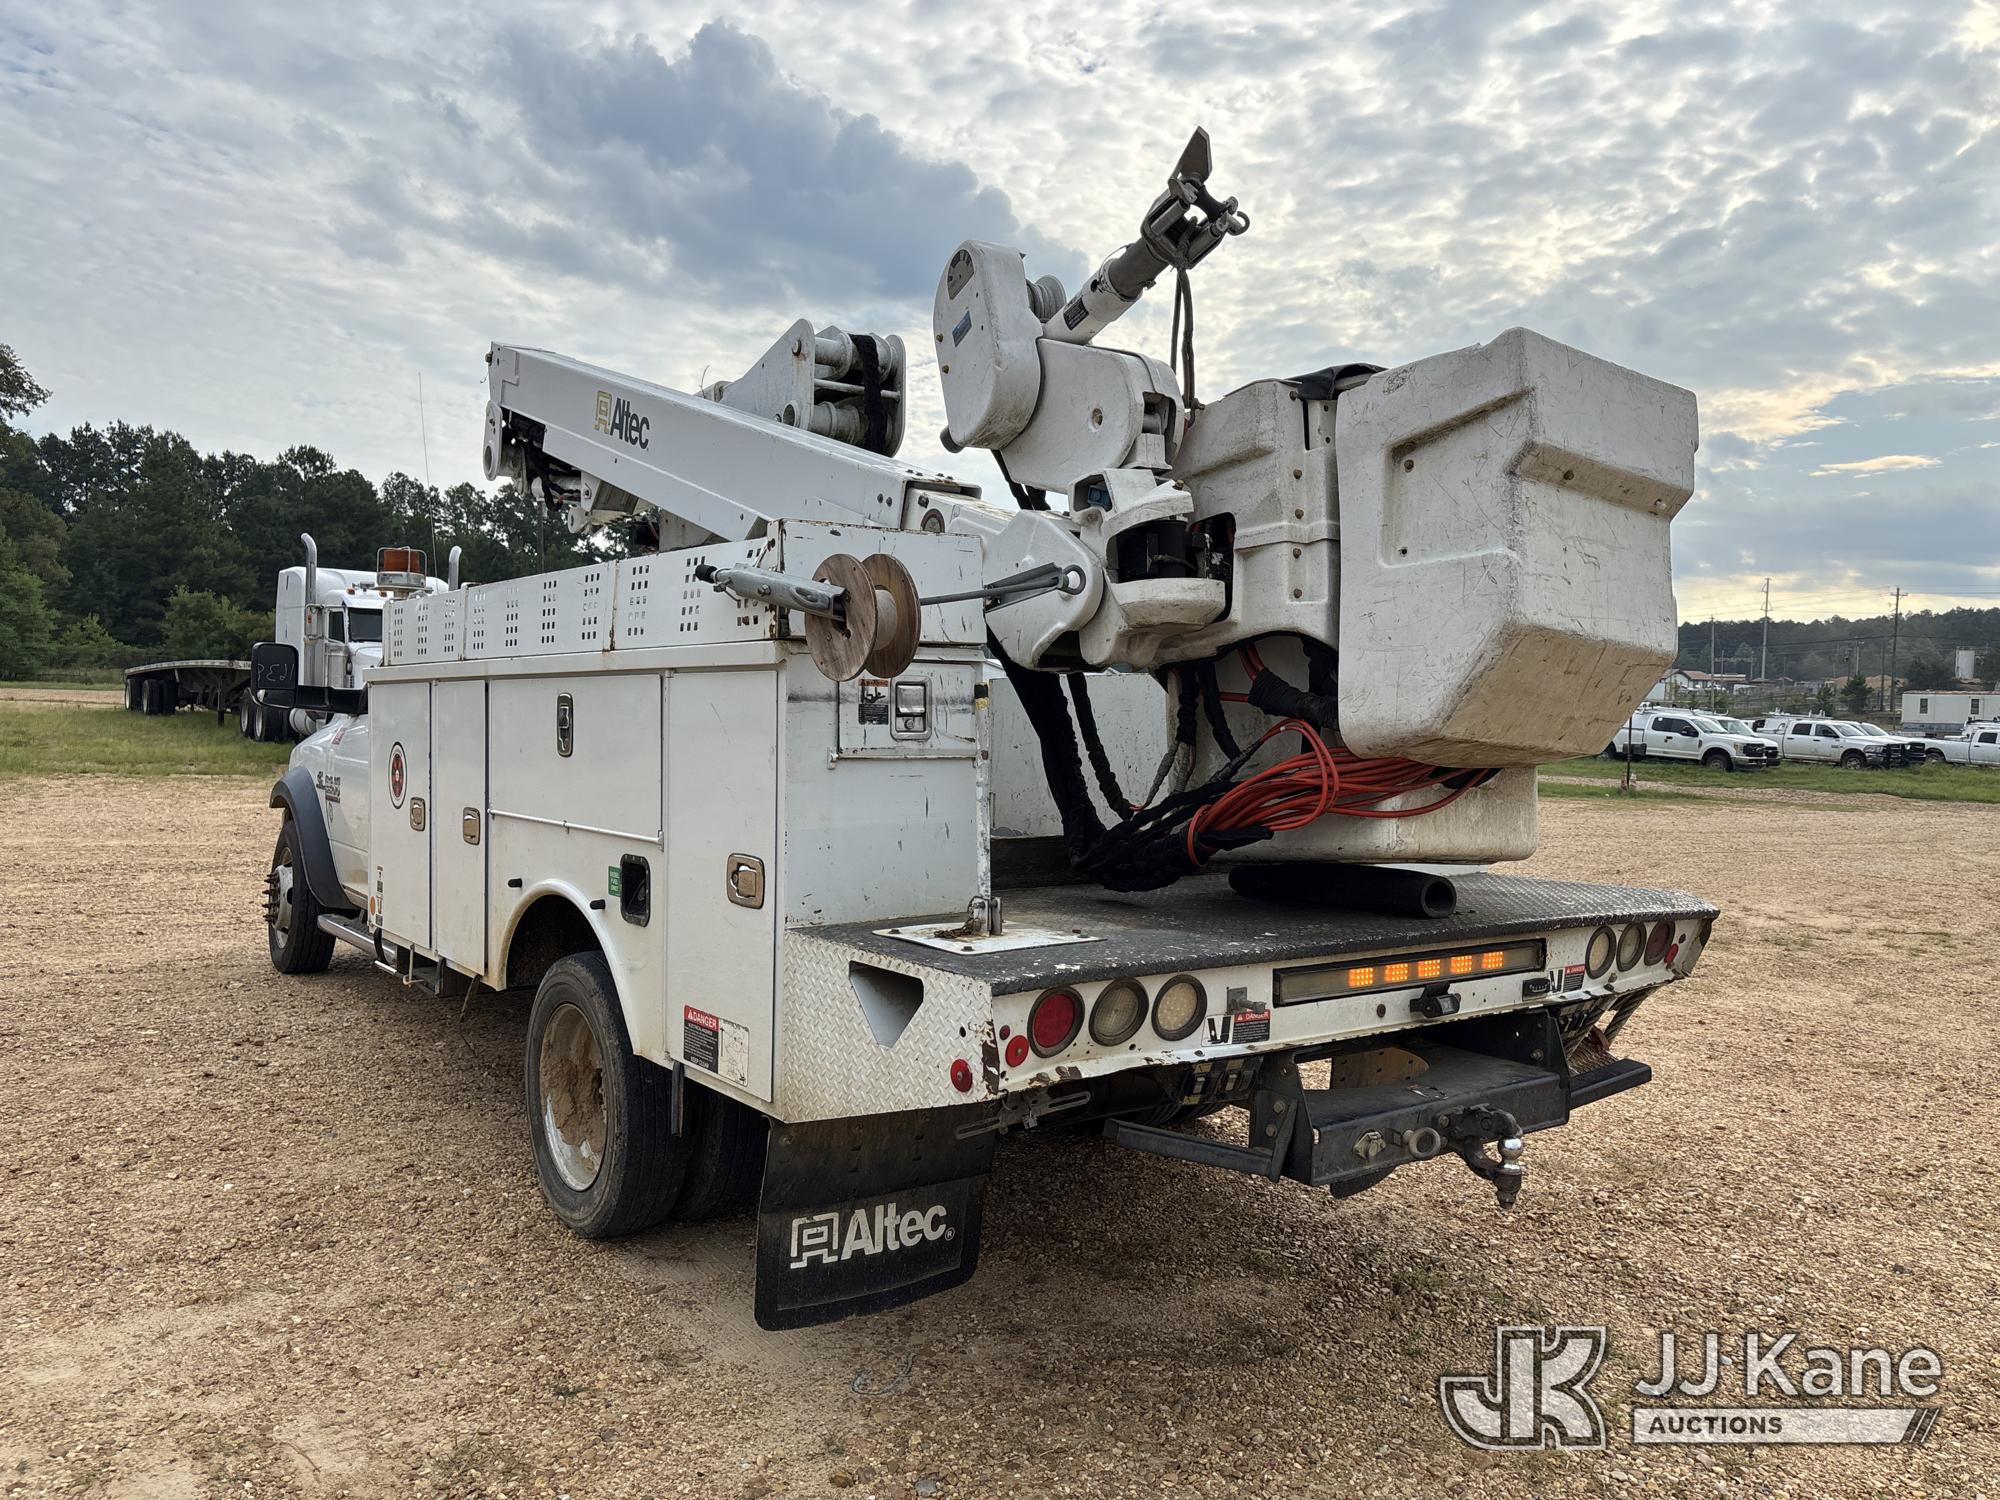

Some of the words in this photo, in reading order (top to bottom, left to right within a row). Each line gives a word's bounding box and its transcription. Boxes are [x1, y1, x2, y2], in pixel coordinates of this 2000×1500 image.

[610, 397, 650, 450] Altec
[693, 1011, 717, 1030] DANGER
[840, 1203, 948, 1261] Altec
